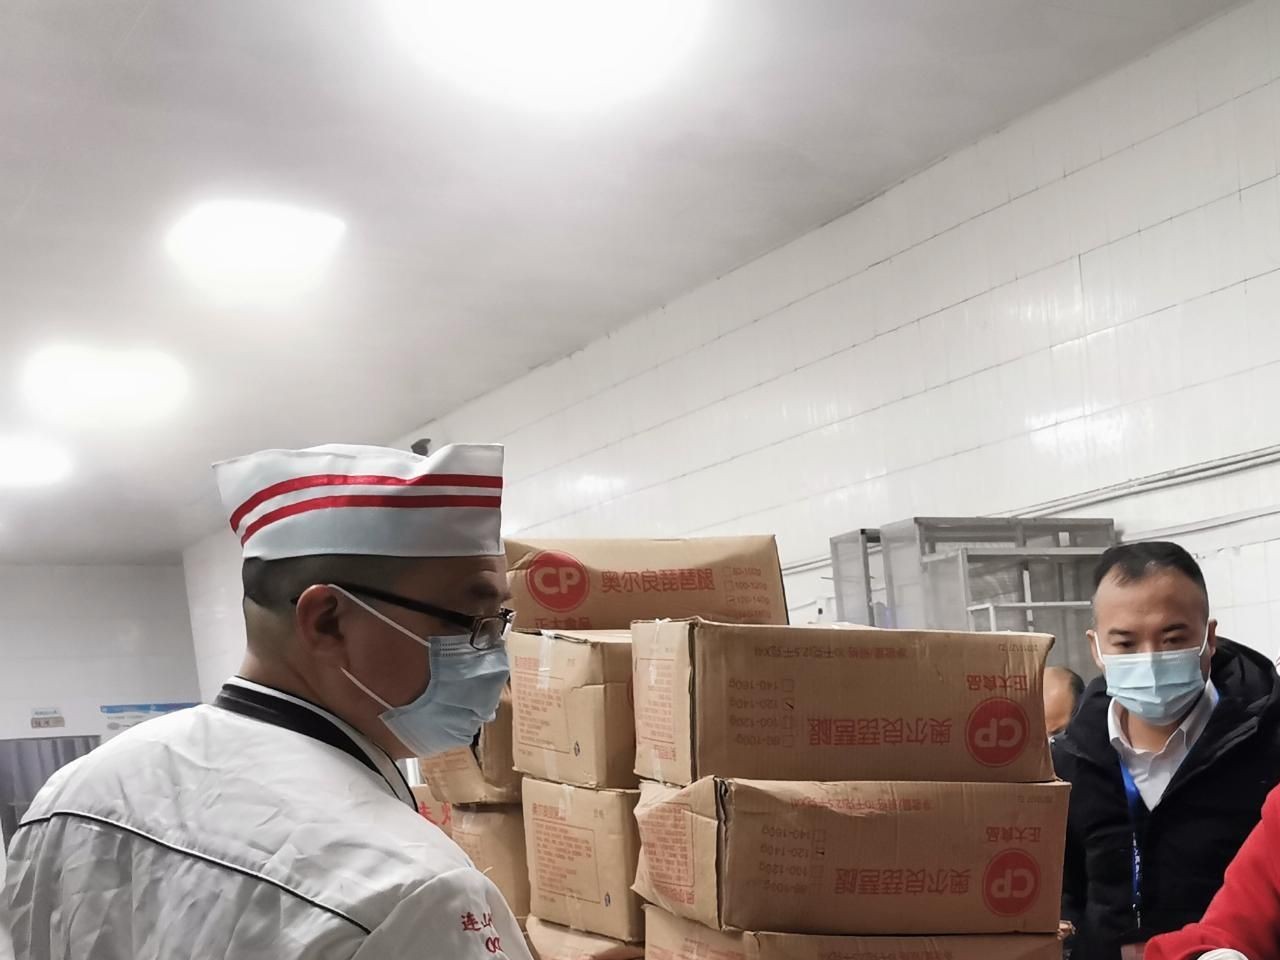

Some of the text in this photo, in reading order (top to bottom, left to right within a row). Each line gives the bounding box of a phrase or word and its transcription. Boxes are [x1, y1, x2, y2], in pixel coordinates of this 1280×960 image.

[534, 566, 580, 595] CP
[601, 567, 716, 593] 奥尔良琵琶腿
[967, 674, 1028, 691] 正大食品
[807, 717, 953, 746] 奥尔良琵琶腿
[975, 717, 1023, 748] CP
[986, 825, 1041, 843] 正大食品
[833, 868, 971, 895] 奥尔良琵琶腿
[991, 870, 1035, 898] CP
